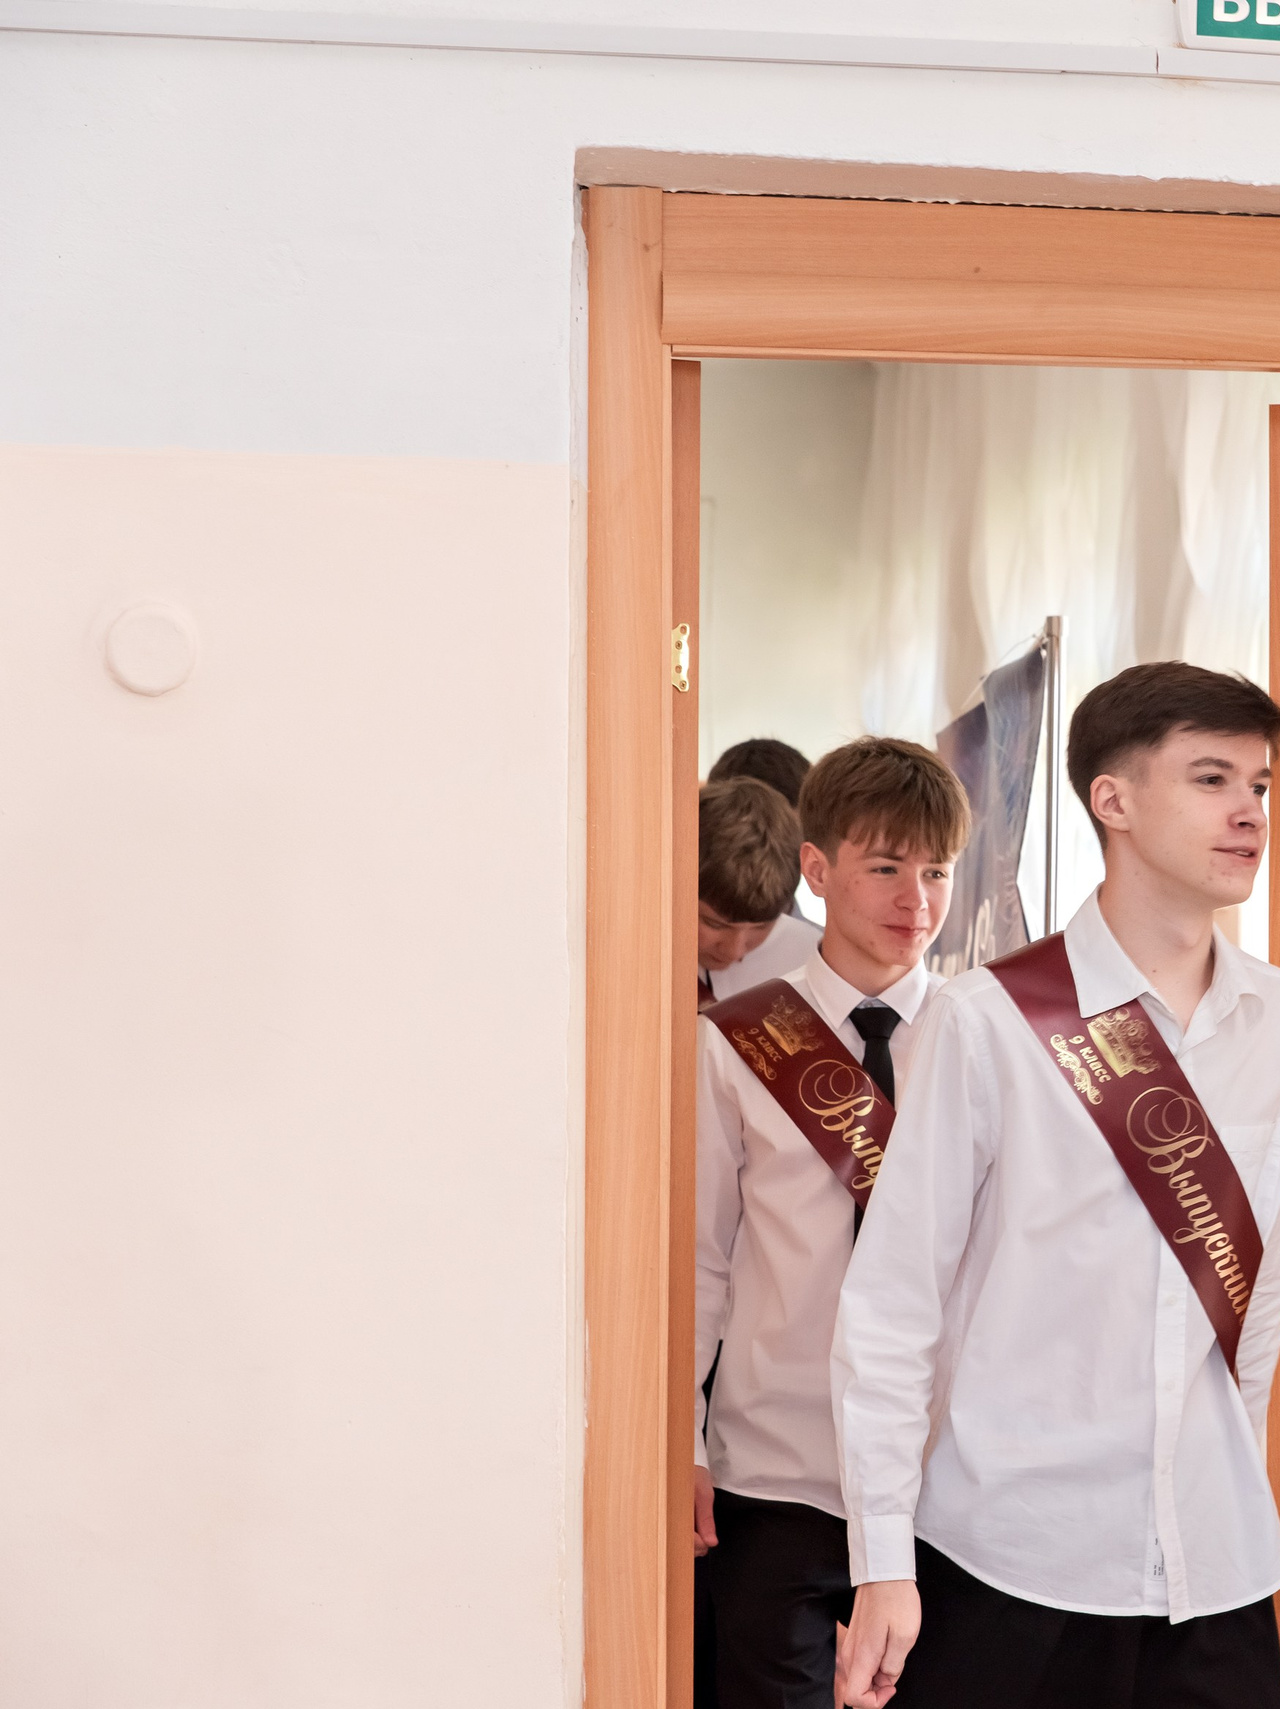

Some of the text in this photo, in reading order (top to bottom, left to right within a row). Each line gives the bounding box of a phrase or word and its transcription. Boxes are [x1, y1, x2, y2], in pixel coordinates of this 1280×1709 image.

[747, 1027, 783, 1062] 9 класс
[1068, 1035, 1112, 1083] 9 класс
